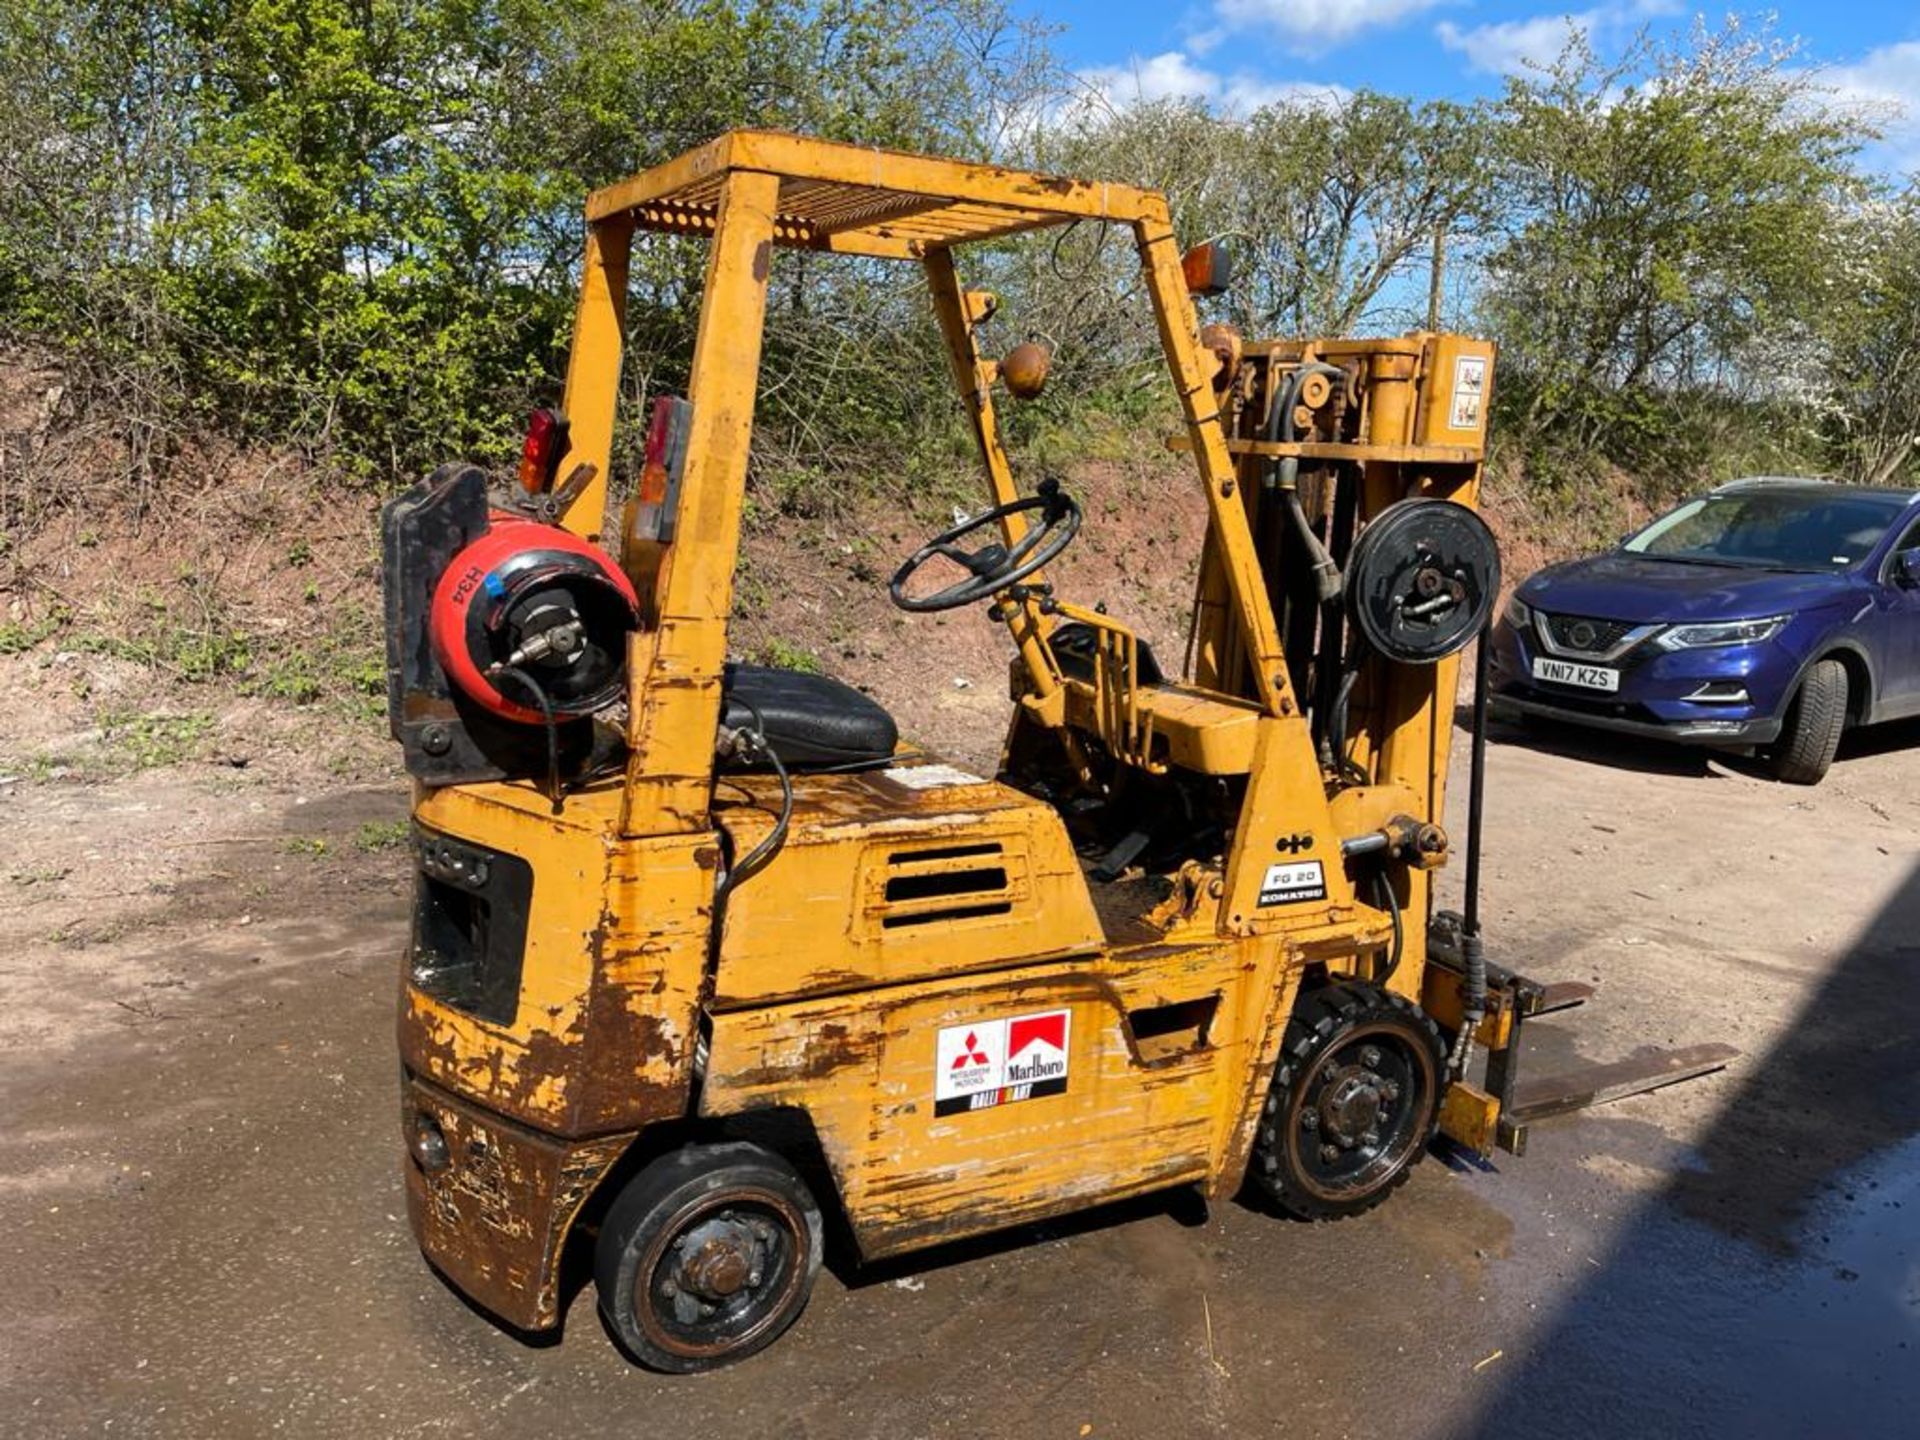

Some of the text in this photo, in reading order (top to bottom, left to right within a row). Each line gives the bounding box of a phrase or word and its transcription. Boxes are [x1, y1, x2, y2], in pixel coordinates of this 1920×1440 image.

[1542, 661, 1609, 687] VN17 KZS
[1273, 871, 1315, 885] FG 20
[1261, 889, 1323, 903] KOMATSU
[1008, 1054, 1064, 1081] Marlboro
